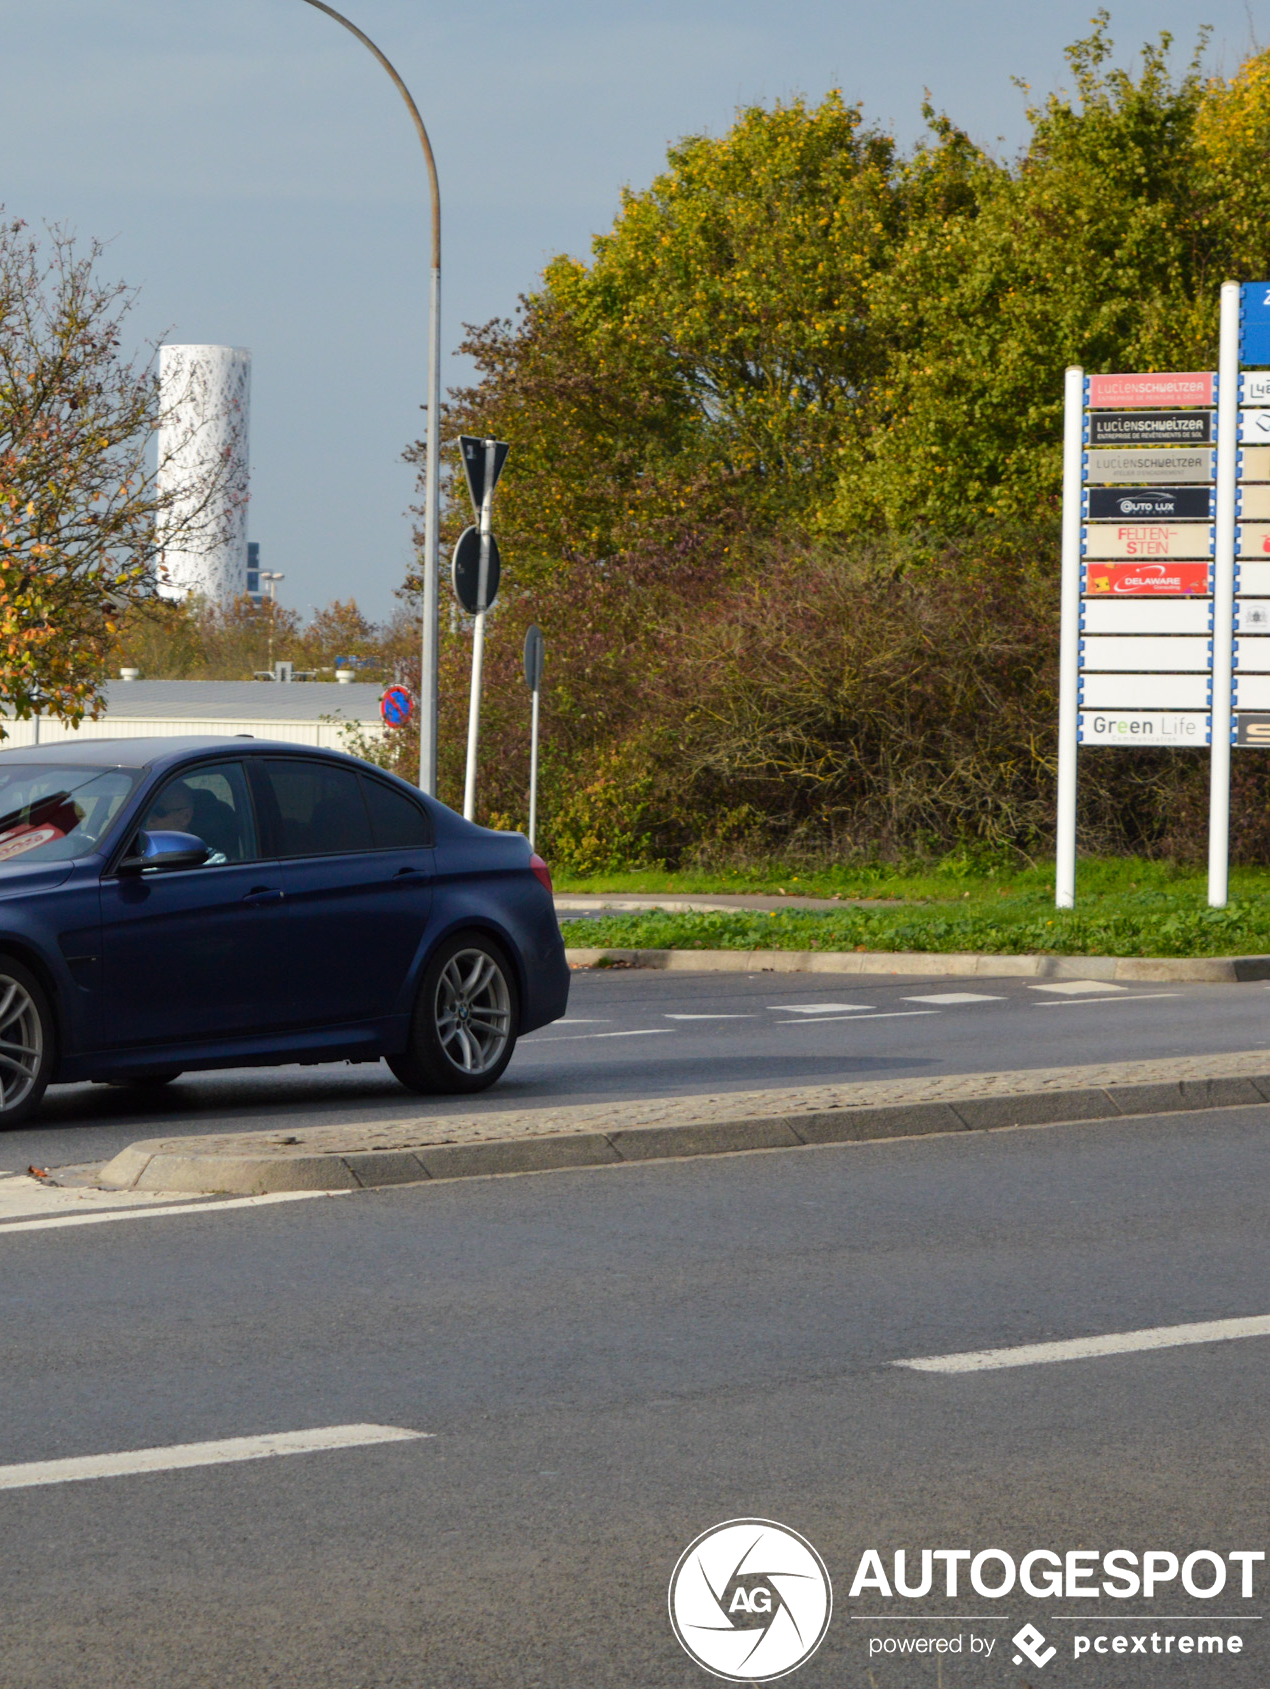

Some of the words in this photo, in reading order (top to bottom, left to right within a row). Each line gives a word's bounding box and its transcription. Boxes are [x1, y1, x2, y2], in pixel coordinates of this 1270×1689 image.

[1155, 502, 1175, 511] LUX
[1126, 541, 1169, 554] STEIN
[1124, 577, 1181, 585] DELAWARE
[1094, 716, 1153, 734] Green
[1161, 716, 1196, 735] Life
